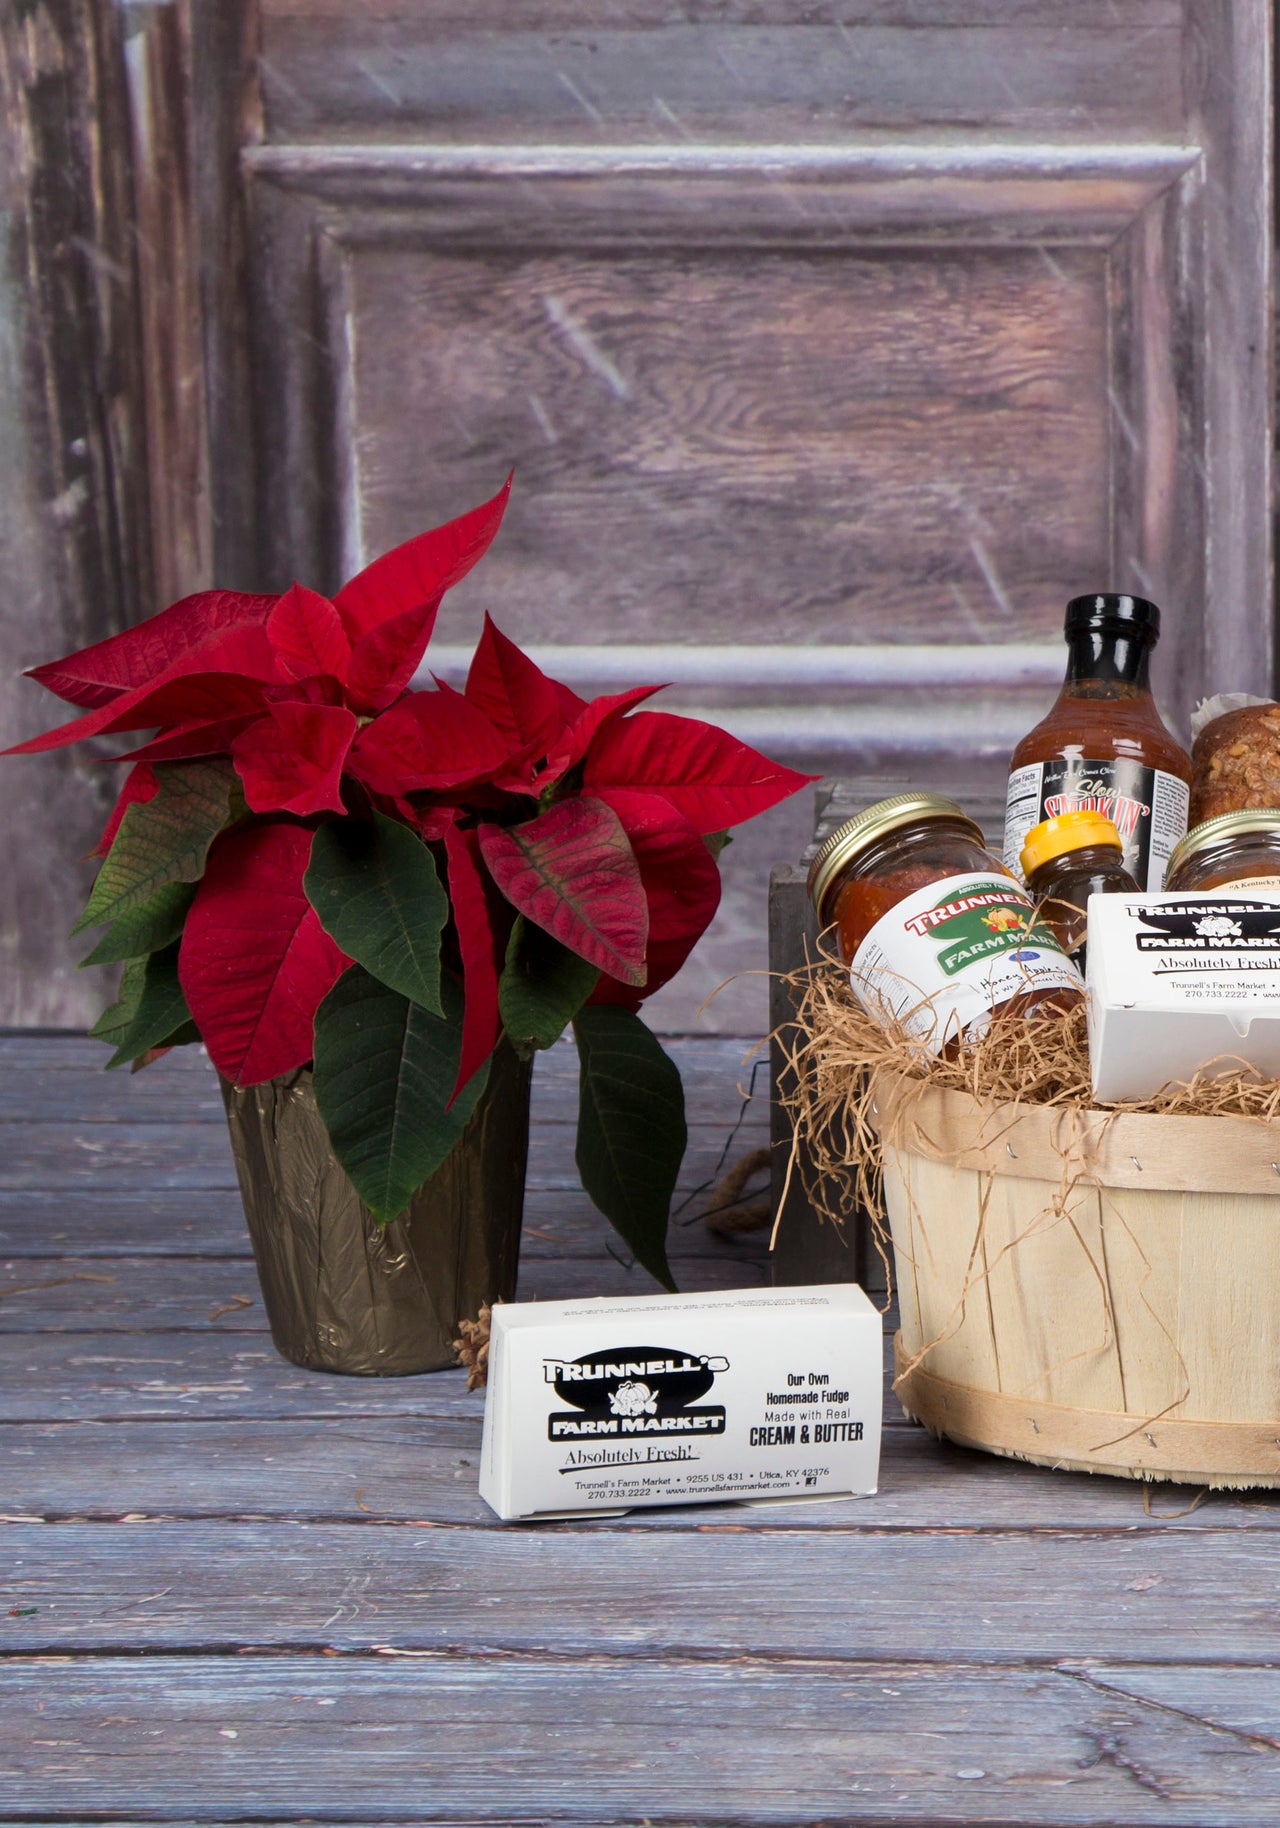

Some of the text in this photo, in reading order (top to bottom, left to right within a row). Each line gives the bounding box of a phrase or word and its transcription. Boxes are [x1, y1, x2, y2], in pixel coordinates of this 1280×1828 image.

[1070, 779, 1121, 801] Slow
[1241, 879, 1275, 889] Kentucky
[1140, 937, 1206, 948] FARM
[944, 936, 1006, 969] FARM
[1157, 957, 1233, 970] Absolutely
[979, 972, 1023, 990] Honey
[1169, 981, 1211, 989] Trunnell's
[1212, 981, 1235, 989] Farm
[1237, 981, 1266, 989] Market
[1184, 990, 1248, 998] 270.733.2222
[542, 1355, 731, 1384] TRUNNELL'S
[787, 1372, 830, 1387] Our Own
[766, 1389, 850, 1406] Homemade Fudge
[764, 1407, 851, 1423] Made with Real
[552, 1415, 725, 1436] FARM MARKET
[749, 1422, 864, 1447] CREAM & BUTTER
[565, 1444, 692, 1465] Absolutely Fresh!
[575, 1467, 830, 1490] Trunnell's Farm Market 9255 US 431 Utica, KY 42376
[587, 1488, 651, 1500] 270.733.2222
[665, 1481, 790, 1495] www.trunnellsfarmmarket.com
